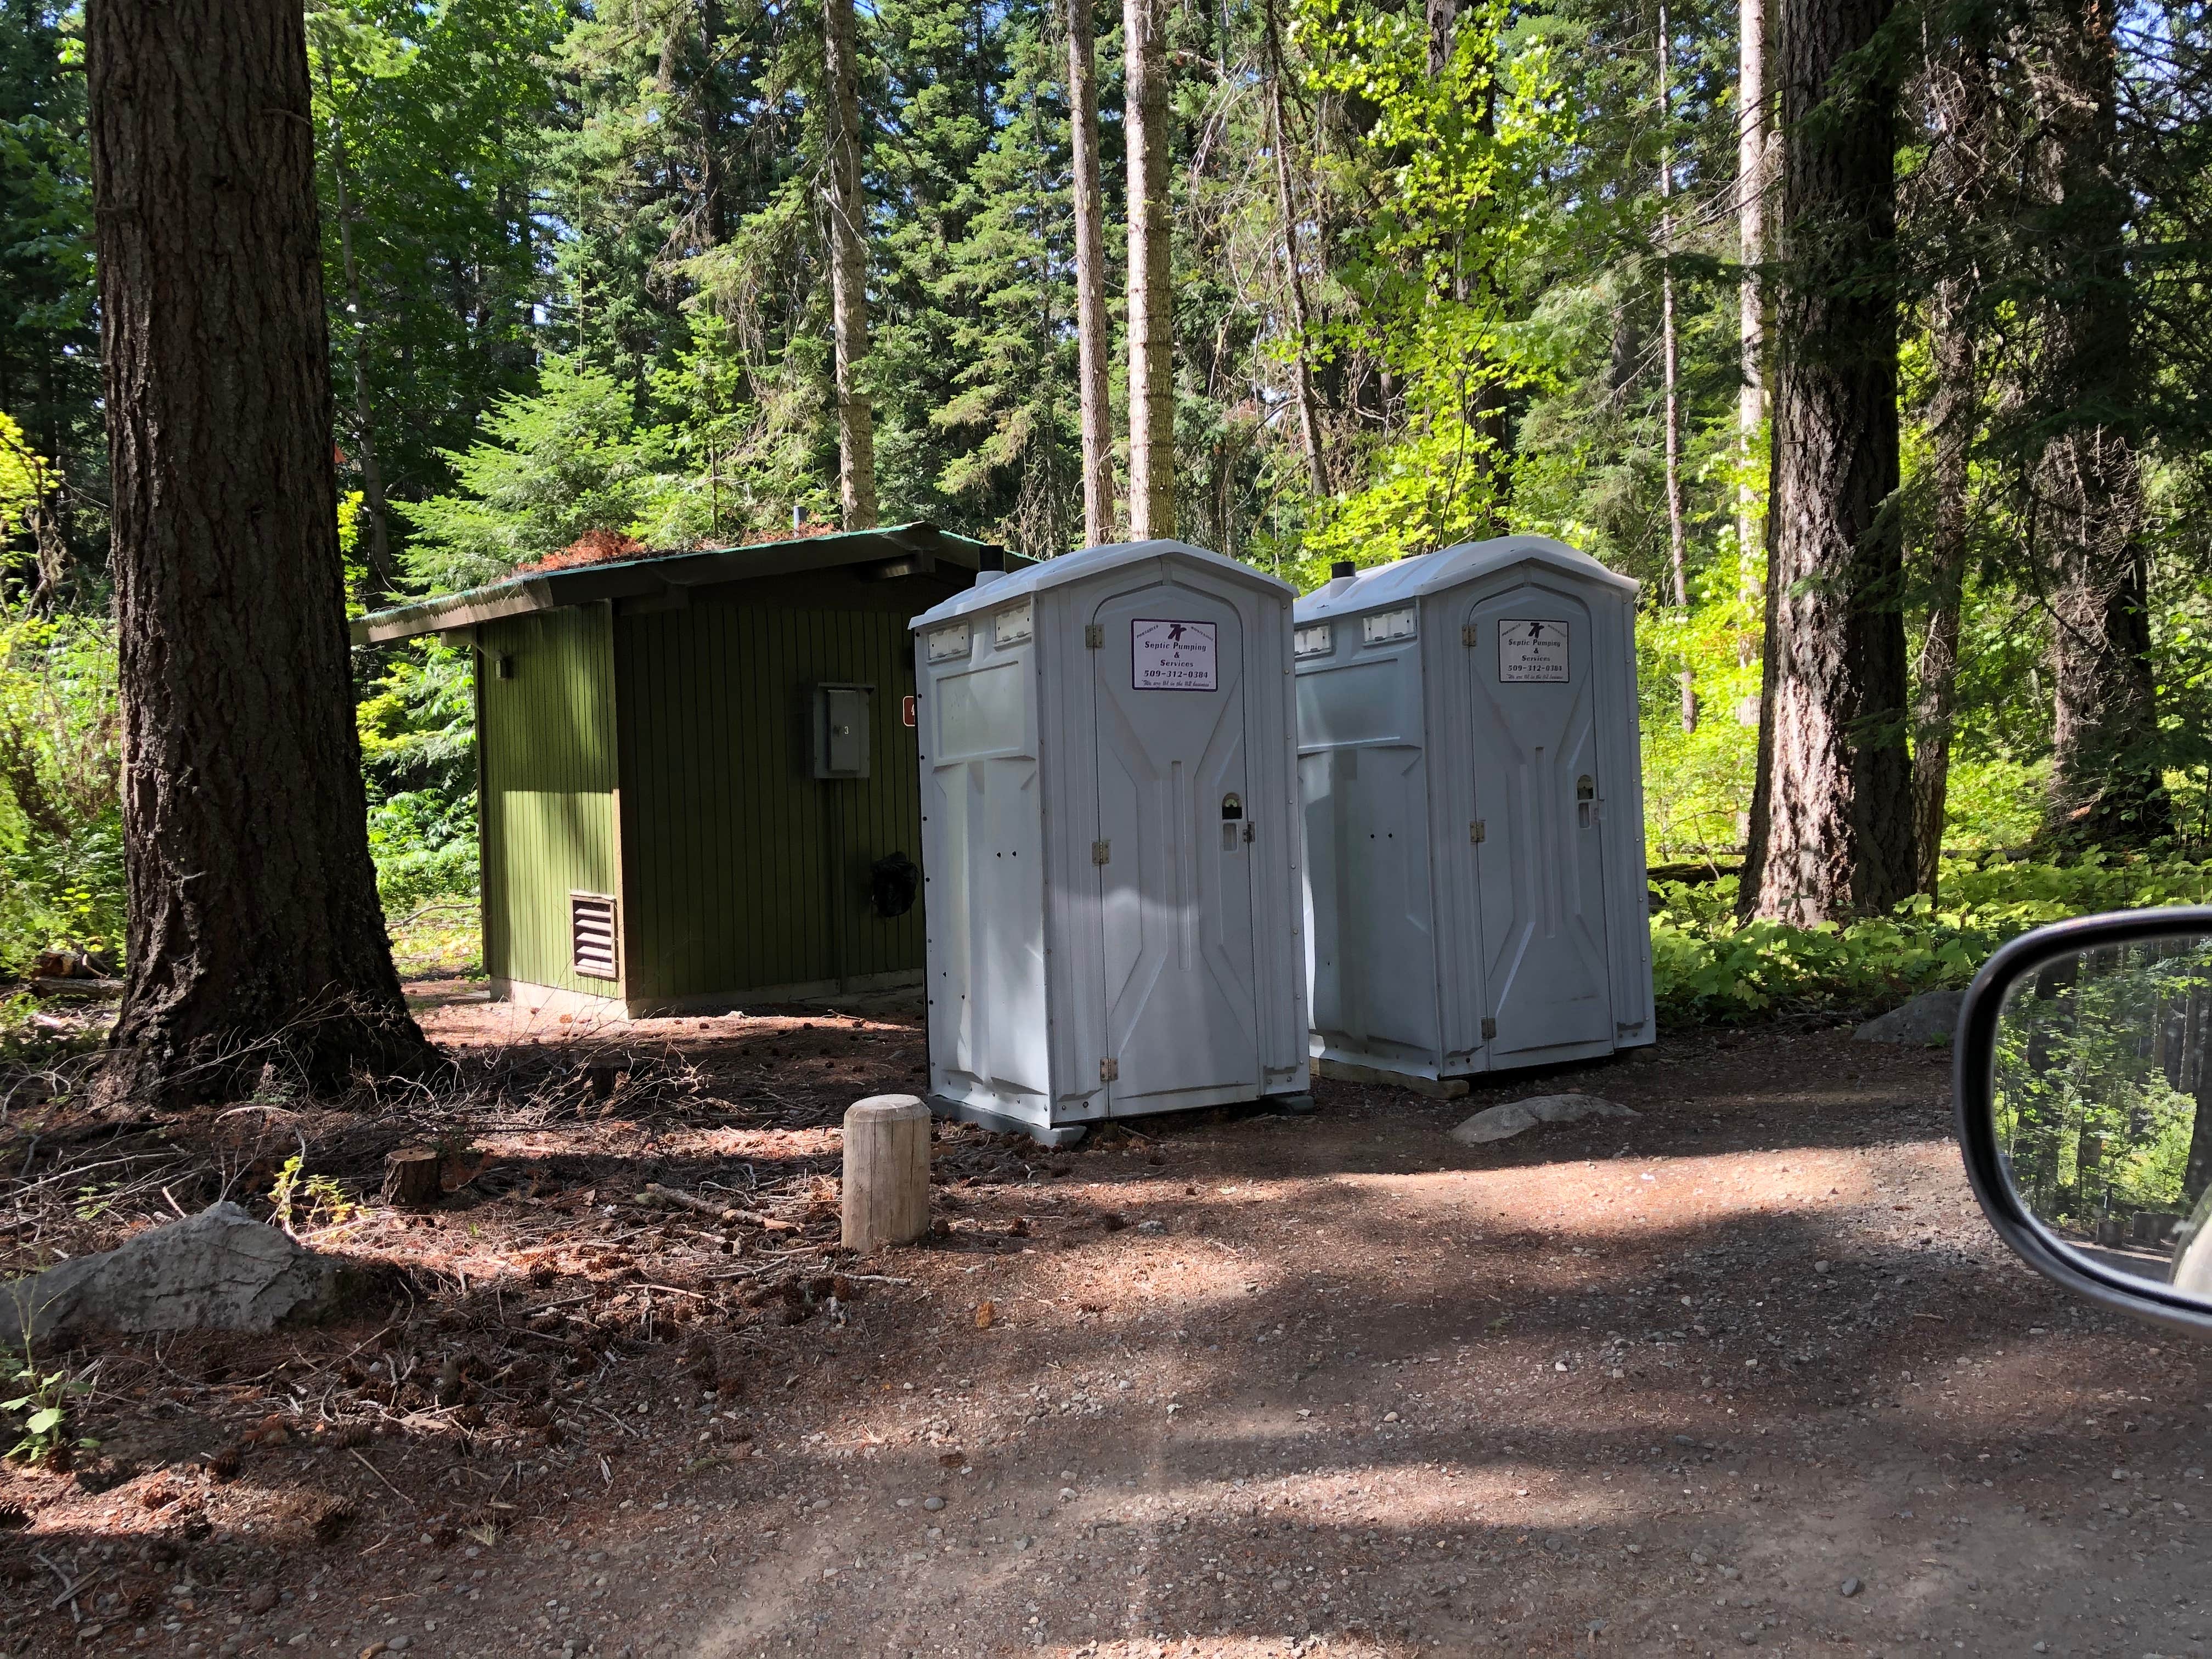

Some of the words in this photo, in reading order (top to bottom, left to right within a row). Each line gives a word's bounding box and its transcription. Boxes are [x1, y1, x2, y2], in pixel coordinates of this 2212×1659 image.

[1144, 641, 1170, 650] Septic
[1173, 642, 1206, 652] Pumping
[1533, 639, 1561, 647] Pumping
[1143, 670, 1208, 678] 509-312-0384
[844, 726, 849, 735] 3
